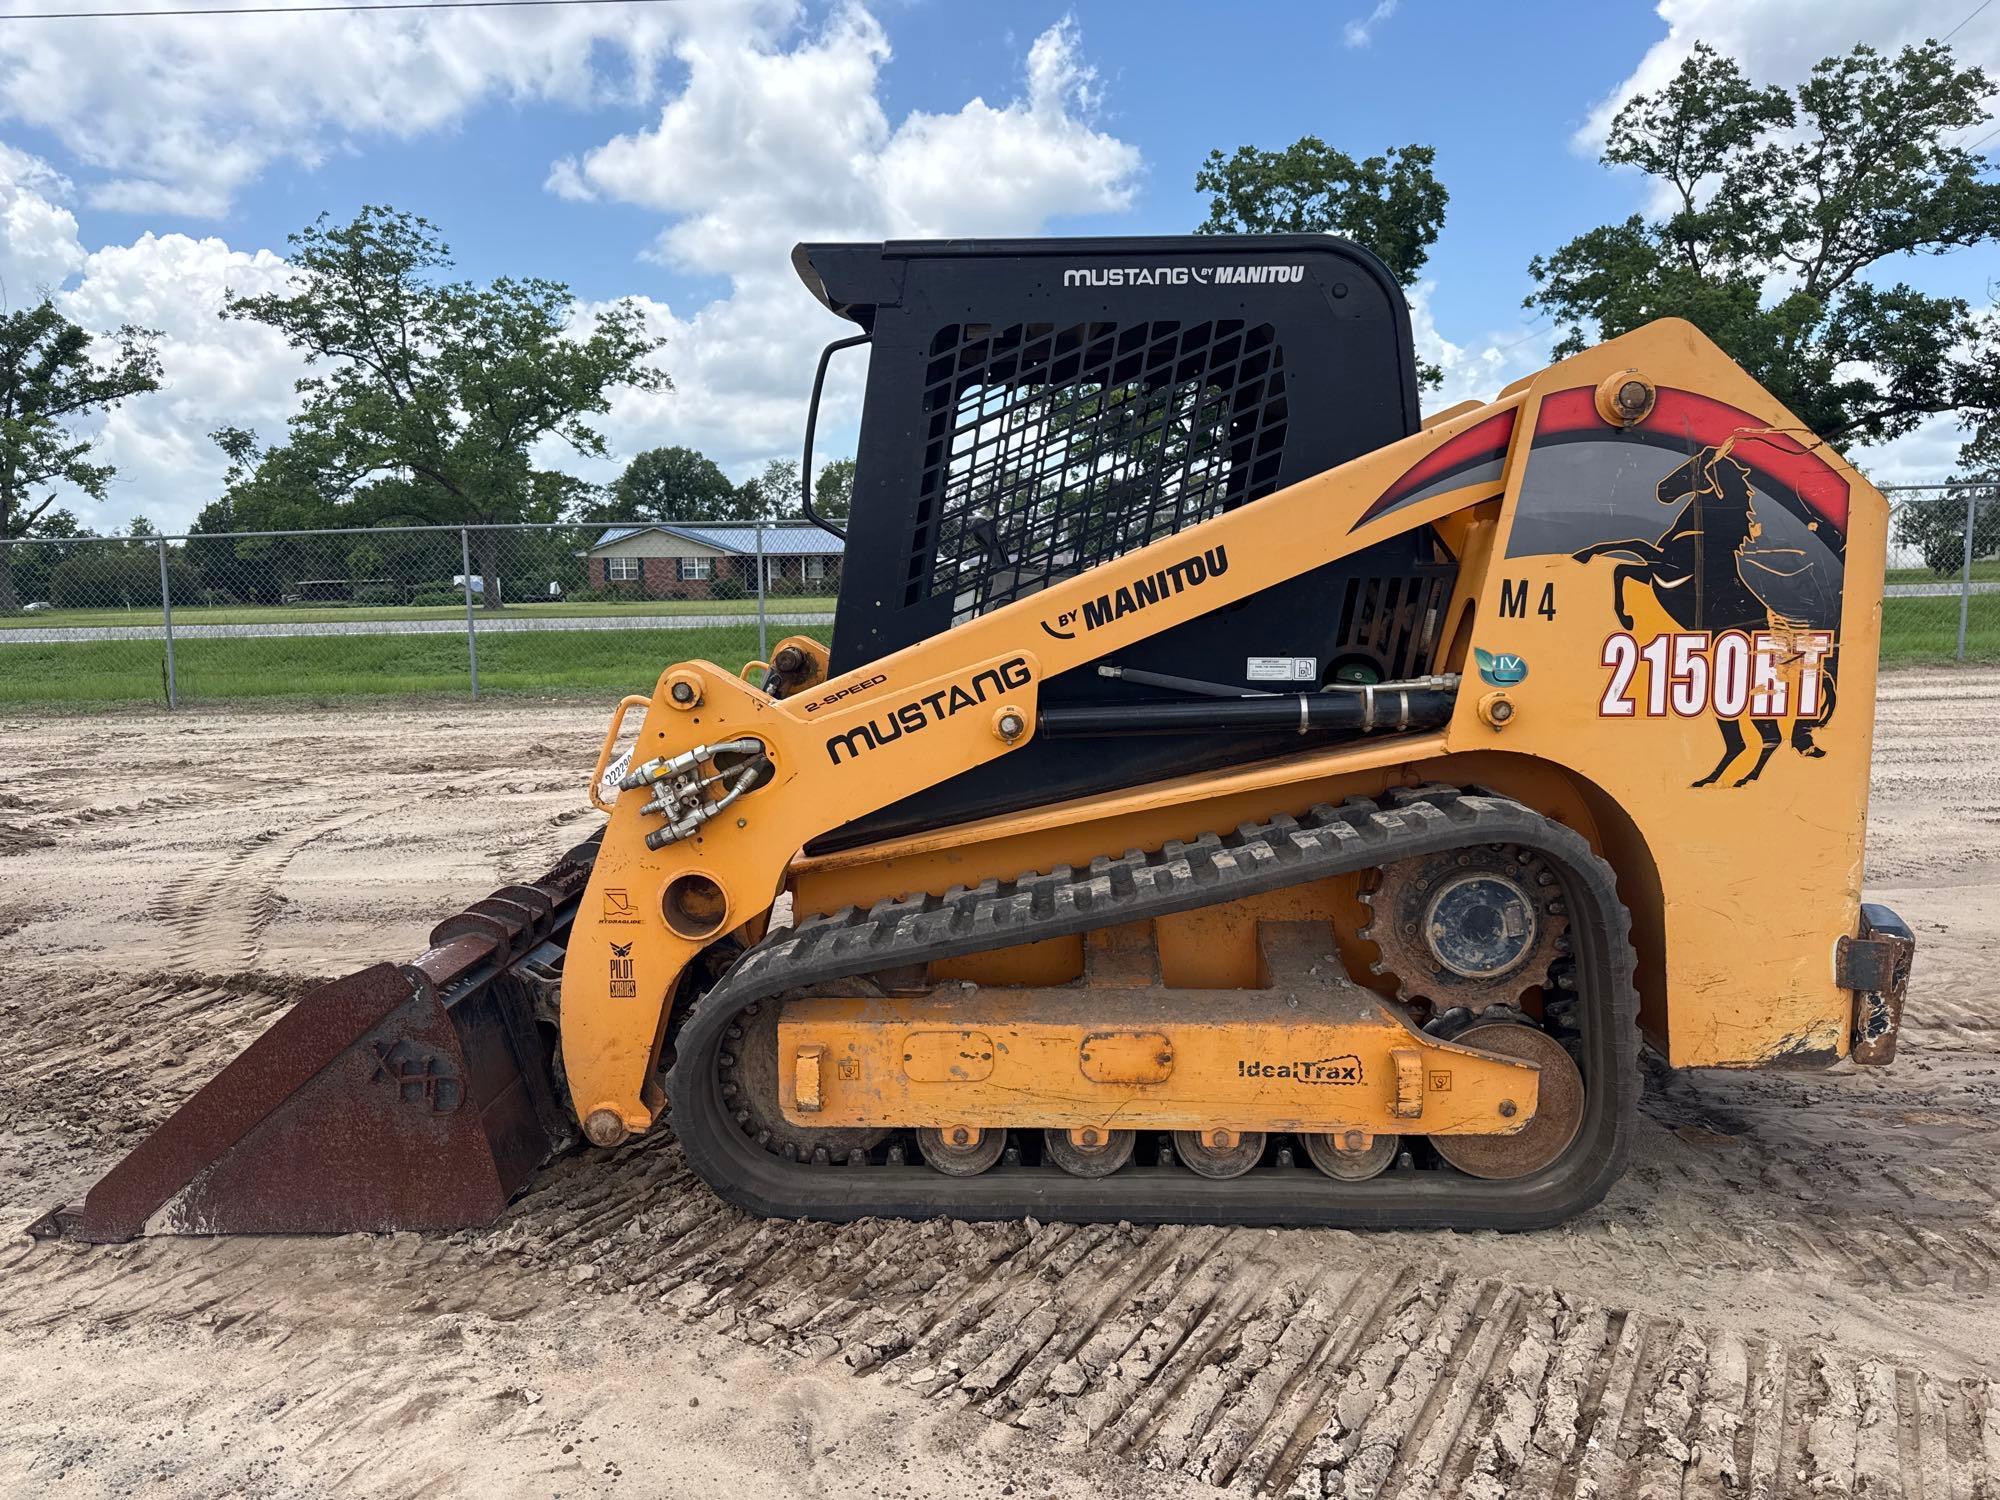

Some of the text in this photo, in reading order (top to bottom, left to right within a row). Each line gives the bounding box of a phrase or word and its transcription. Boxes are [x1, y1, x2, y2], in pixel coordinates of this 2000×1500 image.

[1064, 265, 1304, 287] MUSTANG BY MANITOU
[1058, 544, 1229, 631] BY MANITOU
[1498, 578, 1557, 622] M 4
[1500, 656, 1520, 669] IV
[1600, 631, 1832, 717] 2150RT
[804, 674, 888, 713] 2-SPEED
[826, 657, 1032, 766] MUSTANG
[610, 958, 634, 979] PILOT
[1239, 1060, 1357, 1080] IdealTrax
